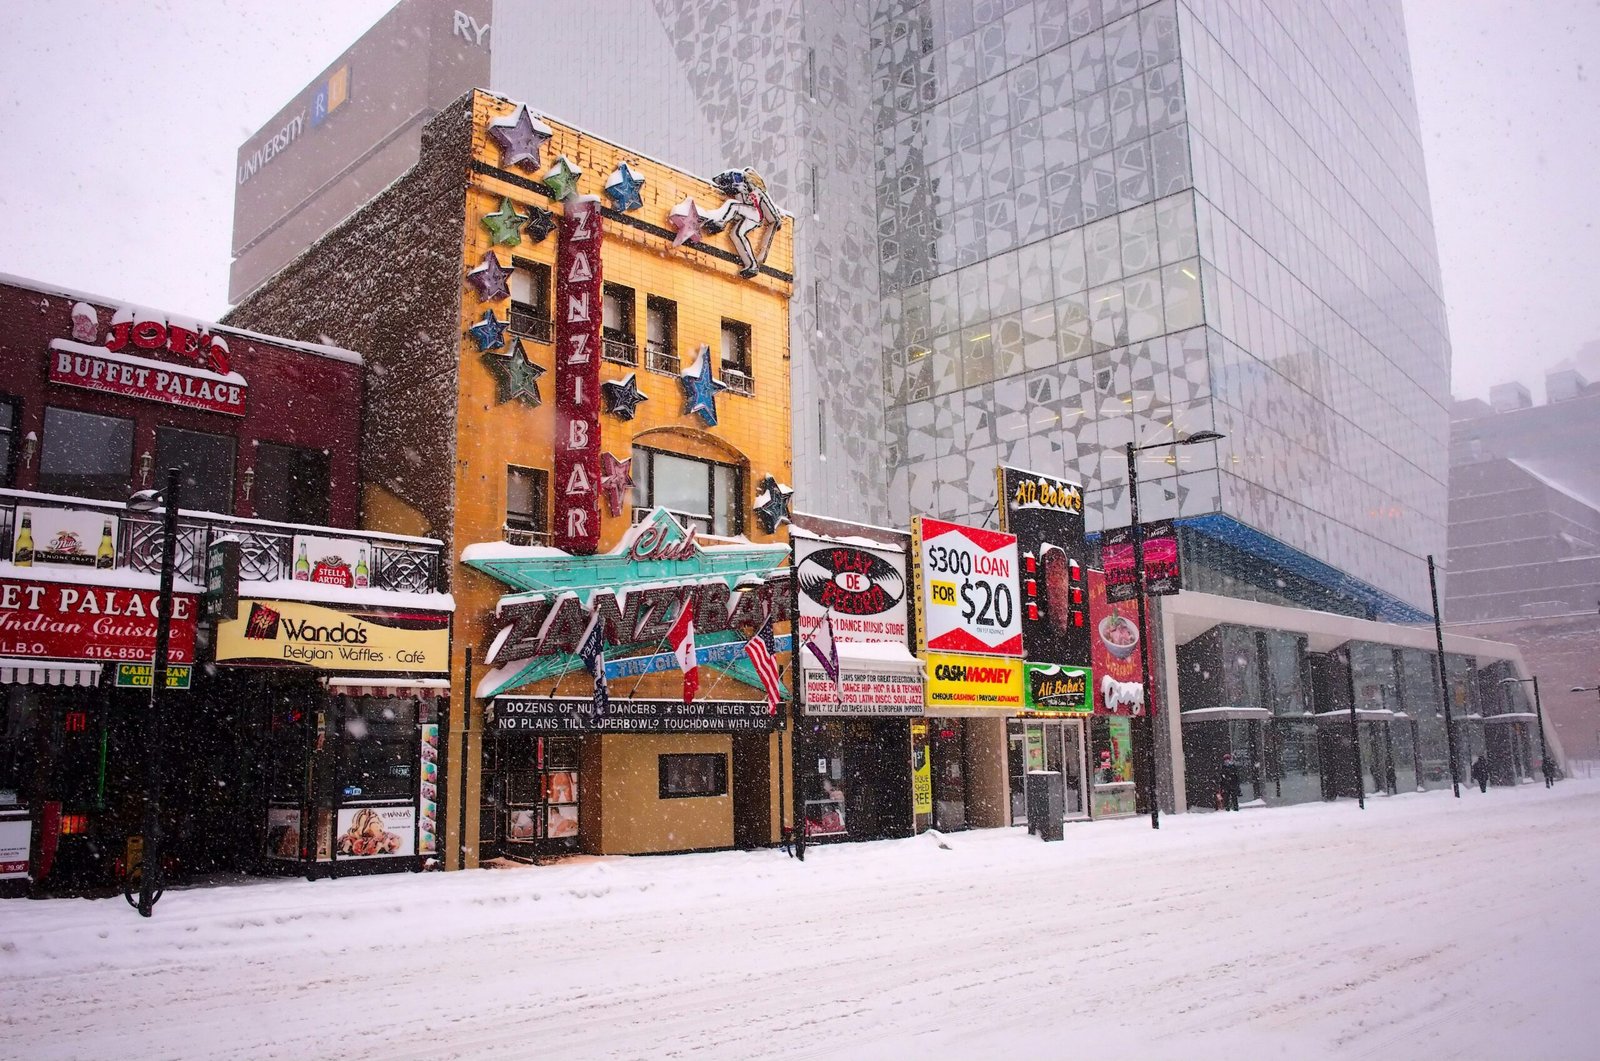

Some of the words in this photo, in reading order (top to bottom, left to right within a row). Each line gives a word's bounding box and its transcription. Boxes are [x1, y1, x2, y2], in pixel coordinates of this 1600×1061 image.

[453, 9, 490, 46] RY
[238, 109, 306, 185] UNIVERSITY
[105, 320, 230, 376] JOE'S
[56, 353, 150, 388] BUFFET
[156, 372, 241, 405] PALACE
[565, 210, 594, 538] ZANZIBAR
[1015, 481, 1036, 504] Ali
[629, 523, 697, 561] Club
[832, 549, 875, 576] PLAY
[928, 545, 972, 577] $300
[974, 555, 1010, 578] LOAN
[318, 576, 347, 585] ARTOIS
[319, 568, 346, 577] STELLA
[845, 573, 861, 591] DE
[0, 584, 46, 610] ET
[821, 578, 885, 615] RECORD
[932, 584, 955, 603] FOR
[961, 578, 1014, 629] $20
[93, 617, 182, 639] Cuisie
[281, 618, 368, 645] Wanda's
[841, 619, 862, 633] DANCE
[863, 621, 884, 635] MUSIC
[885, 623, 905, 636] STORE
[283, 645, 334, 663] Belgian
[338, 647, 384, 662] Waffles
[396, 650, 426, 664] Café
[121, 665, 189, 678] CARIEAN
[809, 672, 825, 681] WHERE
[854, 674, 866, 682] SHOP
[808, 682, 827, 692] HOUSE
[843, 683, 860, 693] DANCE
[902, 685, 922, 694] TECHNO
[808, 692, 832, 703] REGGAE
[932, 692, 953, 701] CHEQUE
[953, 693, 976, 702] CASHING
[997, 695, 1019, 703] ADVANCE
[1037, 681, 1053, 697] Ali
[1055, 678, 1085, 695] Baba's
[507, 702, 555, 713] DOZENS
[559, 703, 574, 713] OF
[609, 704, 657, 715] DANCERS
[676, 704, 705, 715] SHOW
[716, 705, 745, 715] NEVER
[808, 704, 821, 713] VINYL
[878, 706, 903, 714] EUROPEAN
[904, 706, 923, 714] IMPORTS
[499, 718, 516, 729] NO
[521, 718, 559, 729] PLANS
[563, 718, 586, 729] TILL
[663, 719, 724, 729] TOUCHDOWN
[727, 719, 750, 729] WITH
